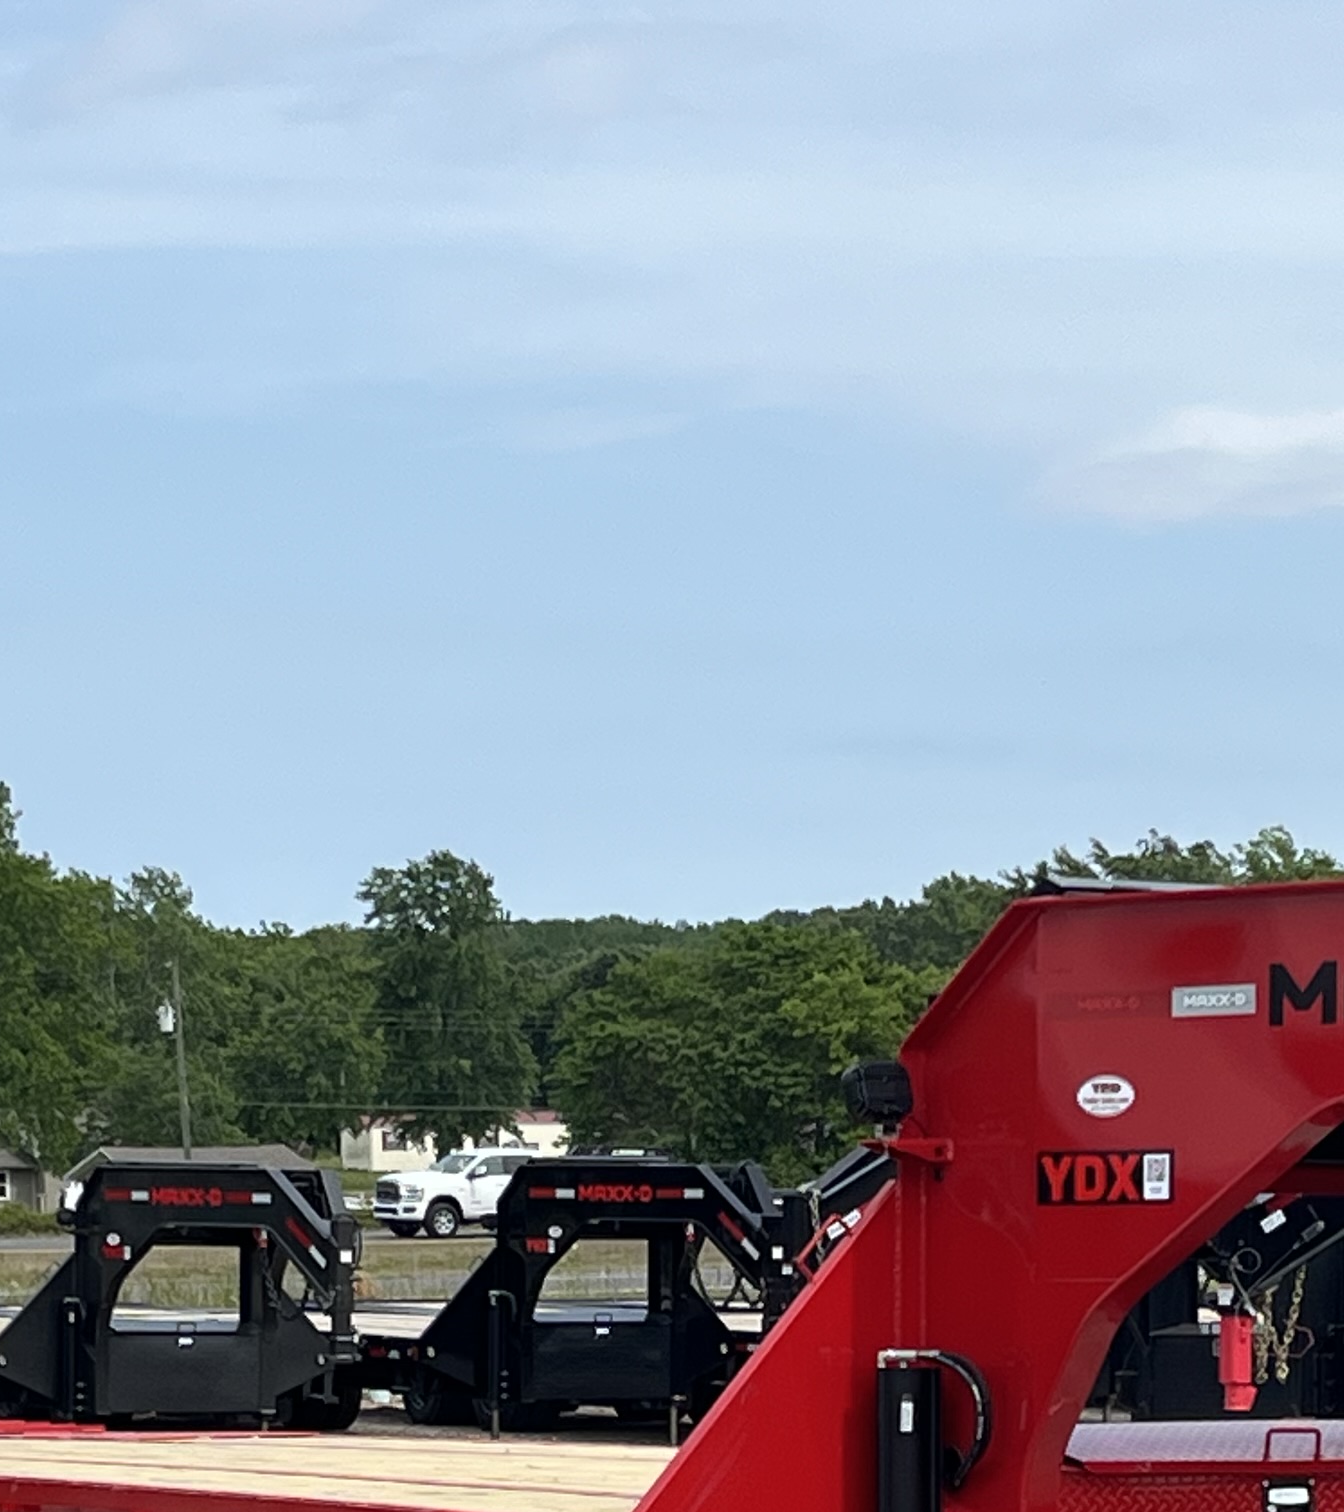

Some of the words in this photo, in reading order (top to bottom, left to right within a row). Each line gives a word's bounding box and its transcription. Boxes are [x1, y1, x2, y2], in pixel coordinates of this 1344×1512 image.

[1183, 991, 1247, 1009] MAXX-D
[1040, 1153, 1141, 1202] YDX
[151, 1187, 223, 1206] MAXX-D
[578, 1184, 654, 1203] MAXX-D
